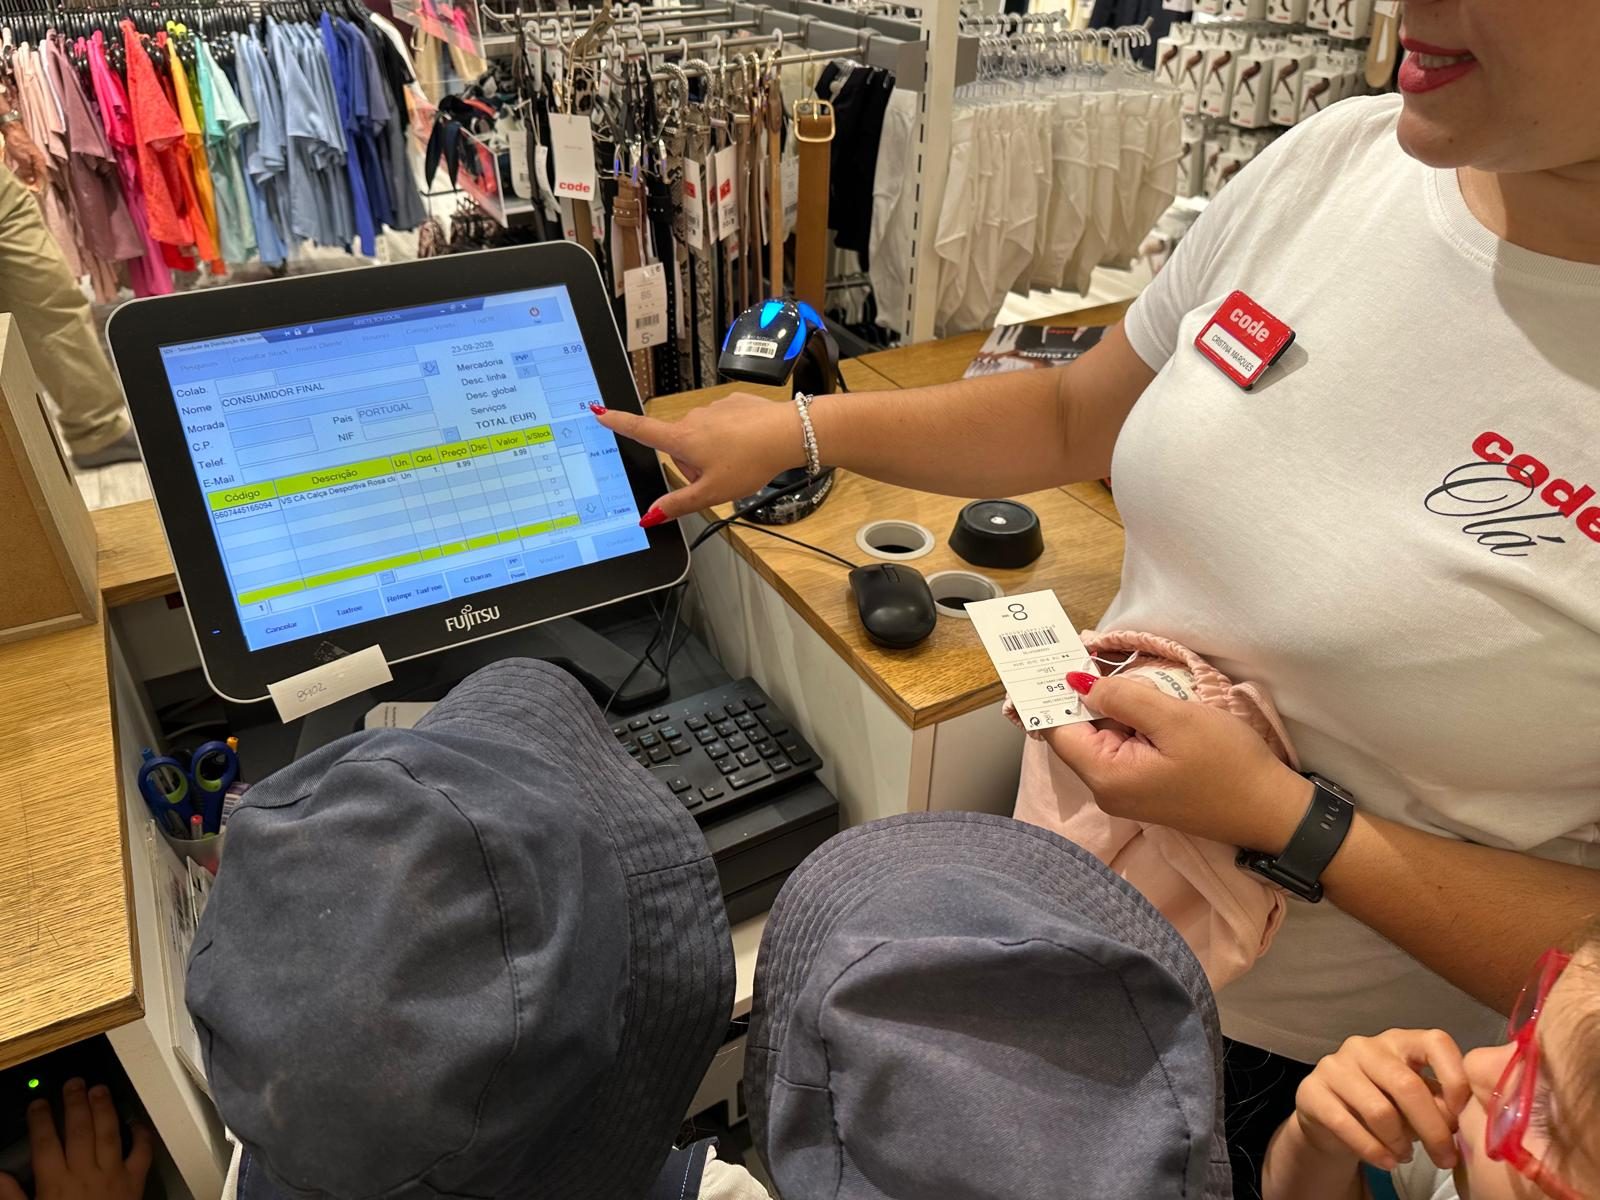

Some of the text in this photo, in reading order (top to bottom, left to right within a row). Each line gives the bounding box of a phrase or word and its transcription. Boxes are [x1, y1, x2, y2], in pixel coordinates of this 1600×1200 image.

[560, 181, 591, 194] code
[1230, 308, 1270, 342] code
[457, 358, 503, 372] Mercadoria
[563, 344, 583, 355] 8.99
[1212, 335, 1255, 372] CRISTINA MARQUES
[487, 372, 507, 382] linha
[176, 386, 208, 399] Colab.
[181, 382, 325, 416] Nome CONSUMIDOR FINAL
[492, 385, 517, 398] global
[358, 402, 413, 418] PORTUGAL
[470, 403, 507, 416] Serviços
[187, 420, 225, 434] Morada
[475, 417, 508, 430] TOTAL
[509, 412, 537, 426] (EUR)
[338, 432, 355, 442] NIF
[224, 489, 261, 503] Código
[311, 468, 358, 485] Descrição
[441, 447, 468, 459] Preço
[496, 436, 519, 447] Valor
[203, 475, 235, 488] E-Mail
[1472, 431, 1600, 543] code
[294, 494, 307, 503] CA
[307, 489, 328, 499] Calça
[328, 482, 367, 495] Desportiva
[444, 604, 501, 632] FUJITSU
[1007, 603, 1028, 621] 8
[1154, 671, 1189, 701] code
